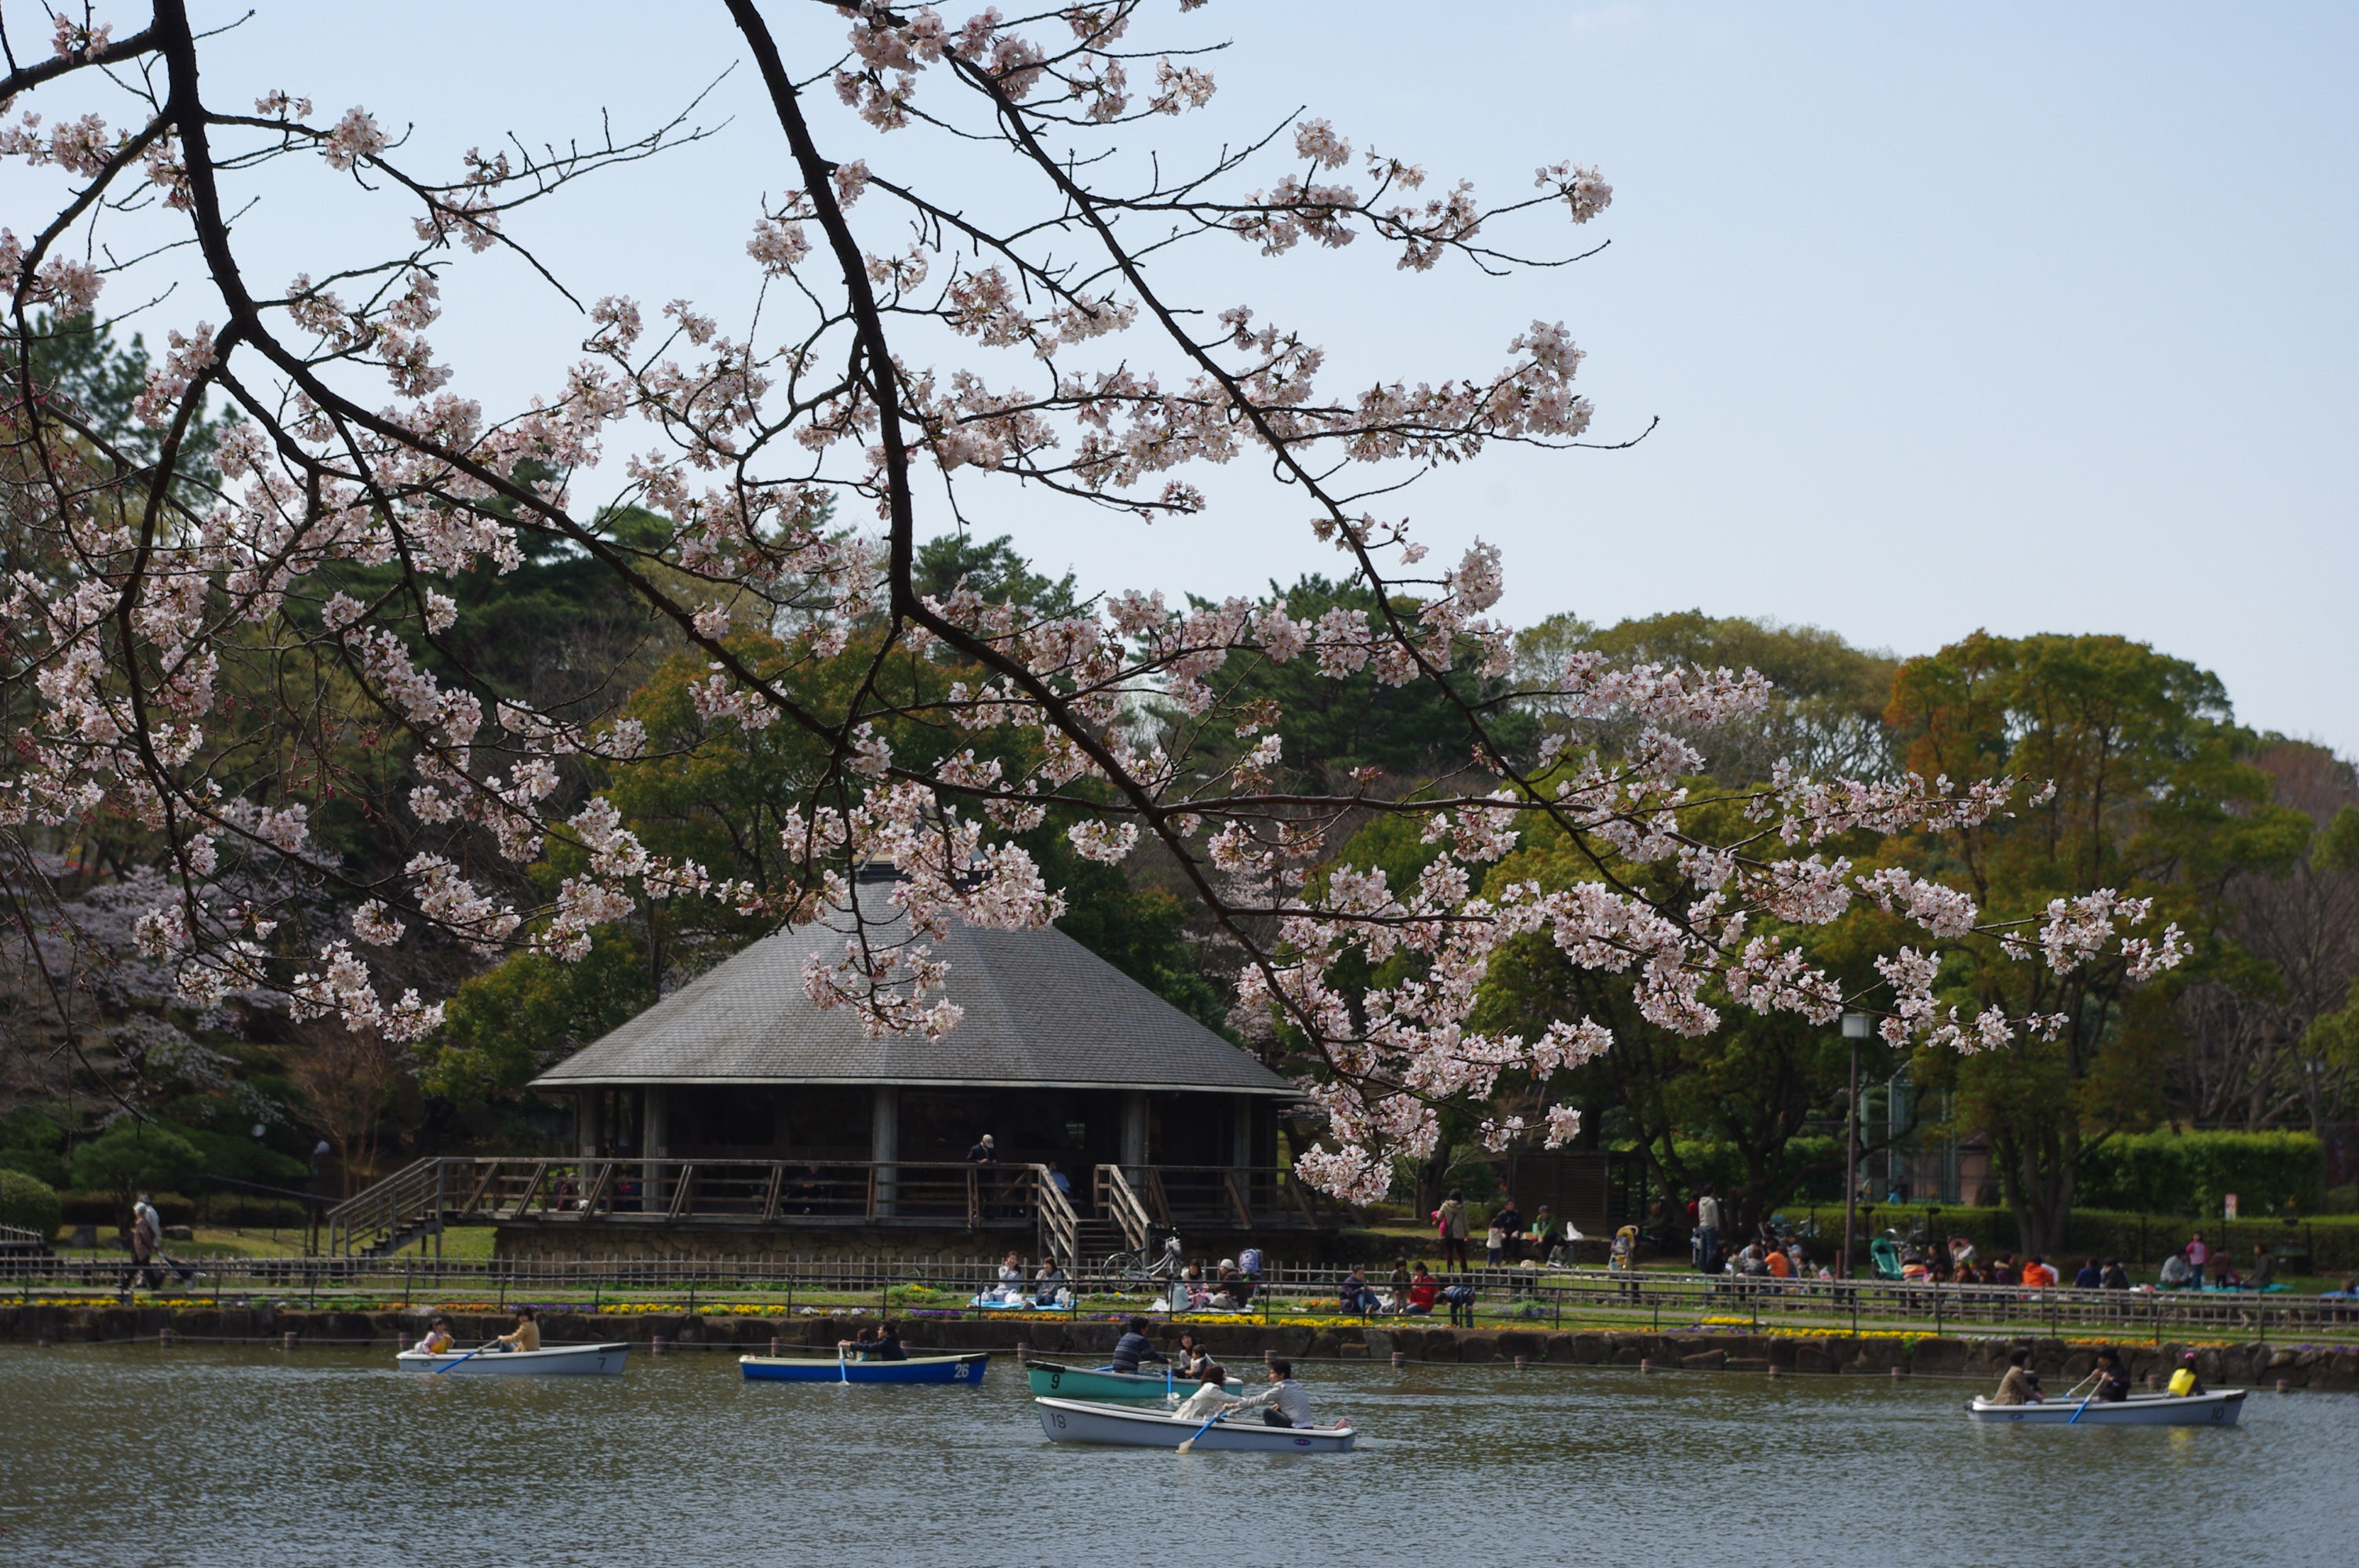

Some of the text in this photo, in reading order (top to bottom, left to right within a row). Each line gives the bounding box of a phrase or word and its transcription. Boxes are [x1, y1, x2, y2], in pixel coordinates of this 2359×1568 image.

[598, 1356, 607, 1370] 7
[954, 1363, 969, 1378] 26
[1051, 1373, 1060, 1389] 9
[1050, 1412, 1067, 1428] 19
[2211, 1406, 2224, 1420] 10
